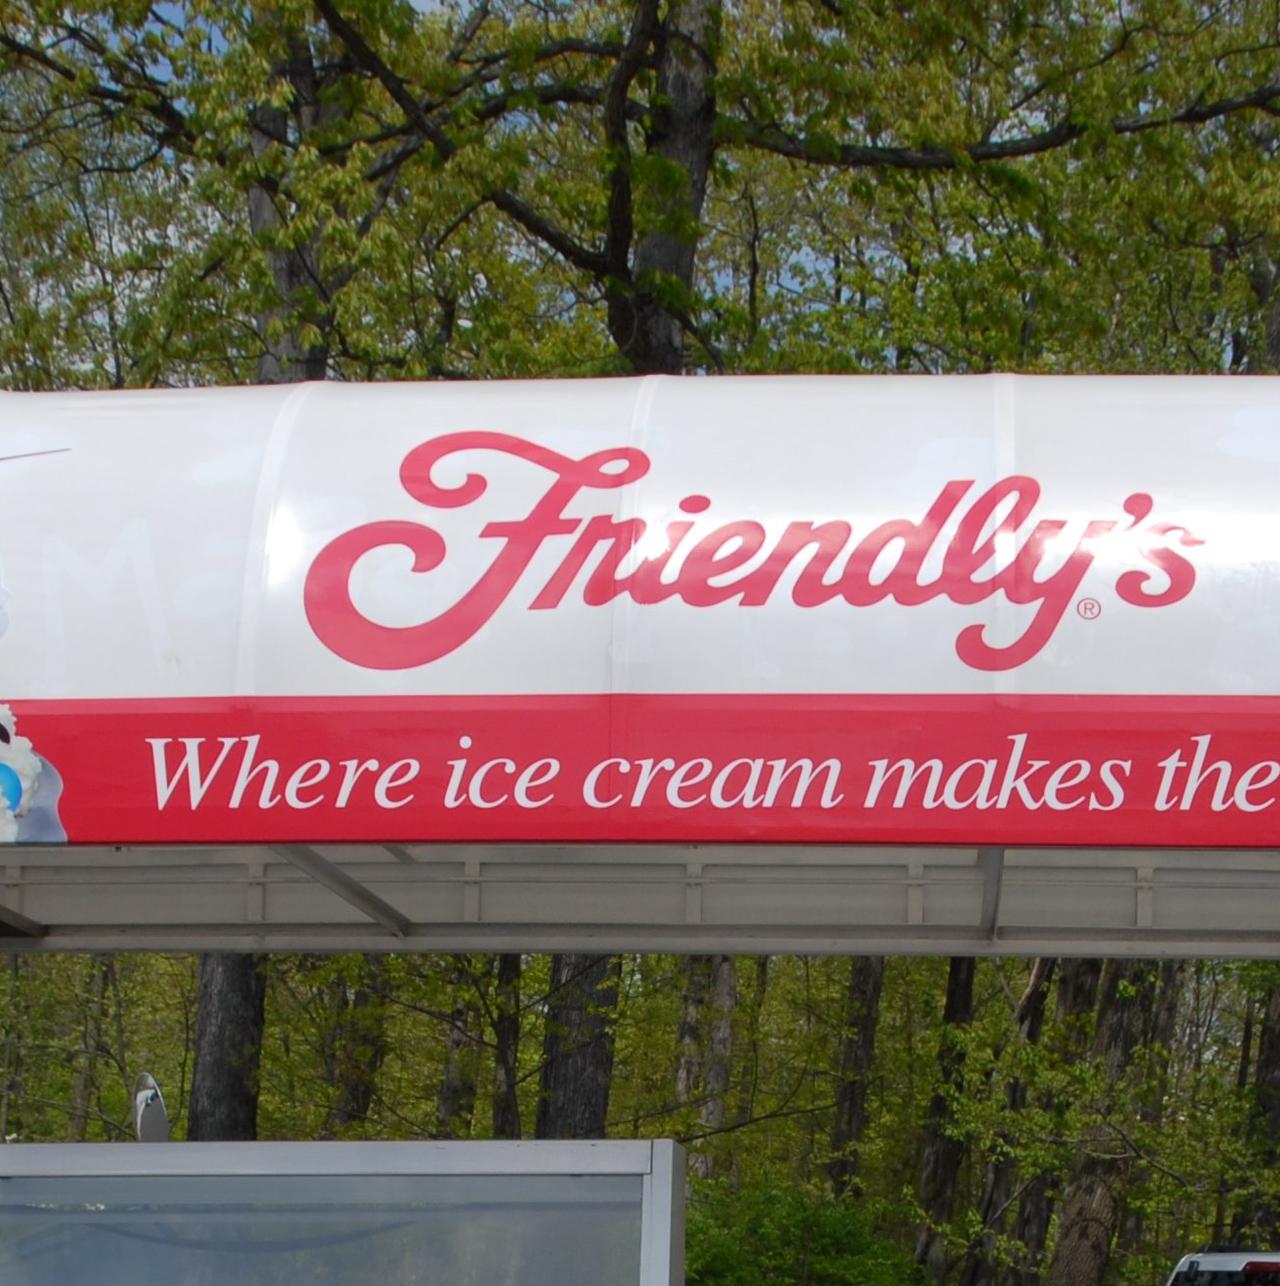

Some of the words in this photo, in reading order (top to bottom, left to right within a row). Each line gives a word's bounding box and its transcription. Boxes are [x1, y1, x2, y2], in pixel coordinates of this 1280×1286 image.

[145, 737, 420, 811] Where
[444, 735, 561, 809] ice
[582, 757, 844, 810] cream
[863, 733, 1132, 811] makes
[1154, 734, 1280, 812] the
